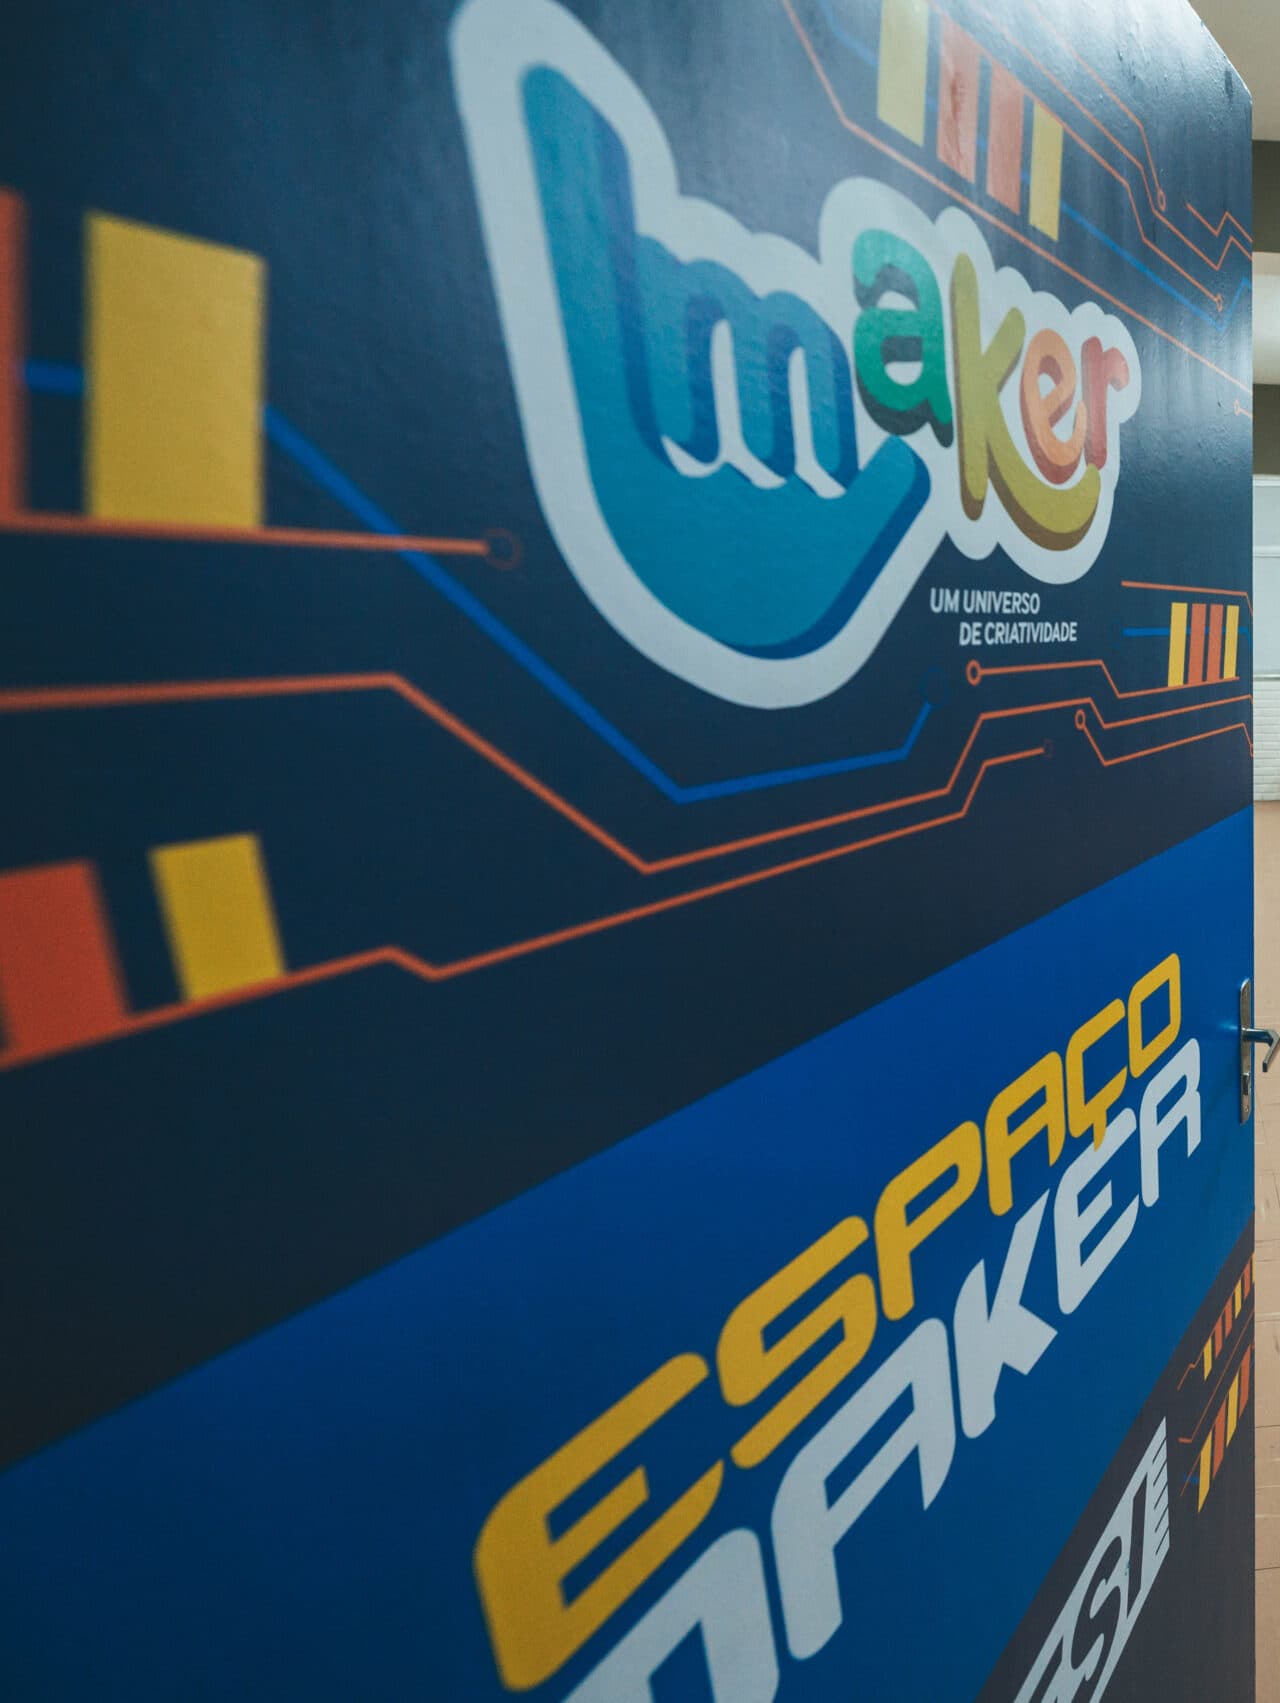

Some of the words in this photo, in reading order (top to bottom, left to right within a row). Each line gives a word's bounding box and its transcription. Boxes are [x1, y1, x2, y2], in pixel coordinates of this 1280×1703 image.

[518, 62, 1130, 664] maker
[930, 587, 960, 614] UM
[963, 589, 1041, 615] UNIVERSO
[959, 621, 982, 646] DE
[984, 621, 1078, 646] CRIATIVIDADE
[474, 952, 1181, 1692] ESPAÇO
